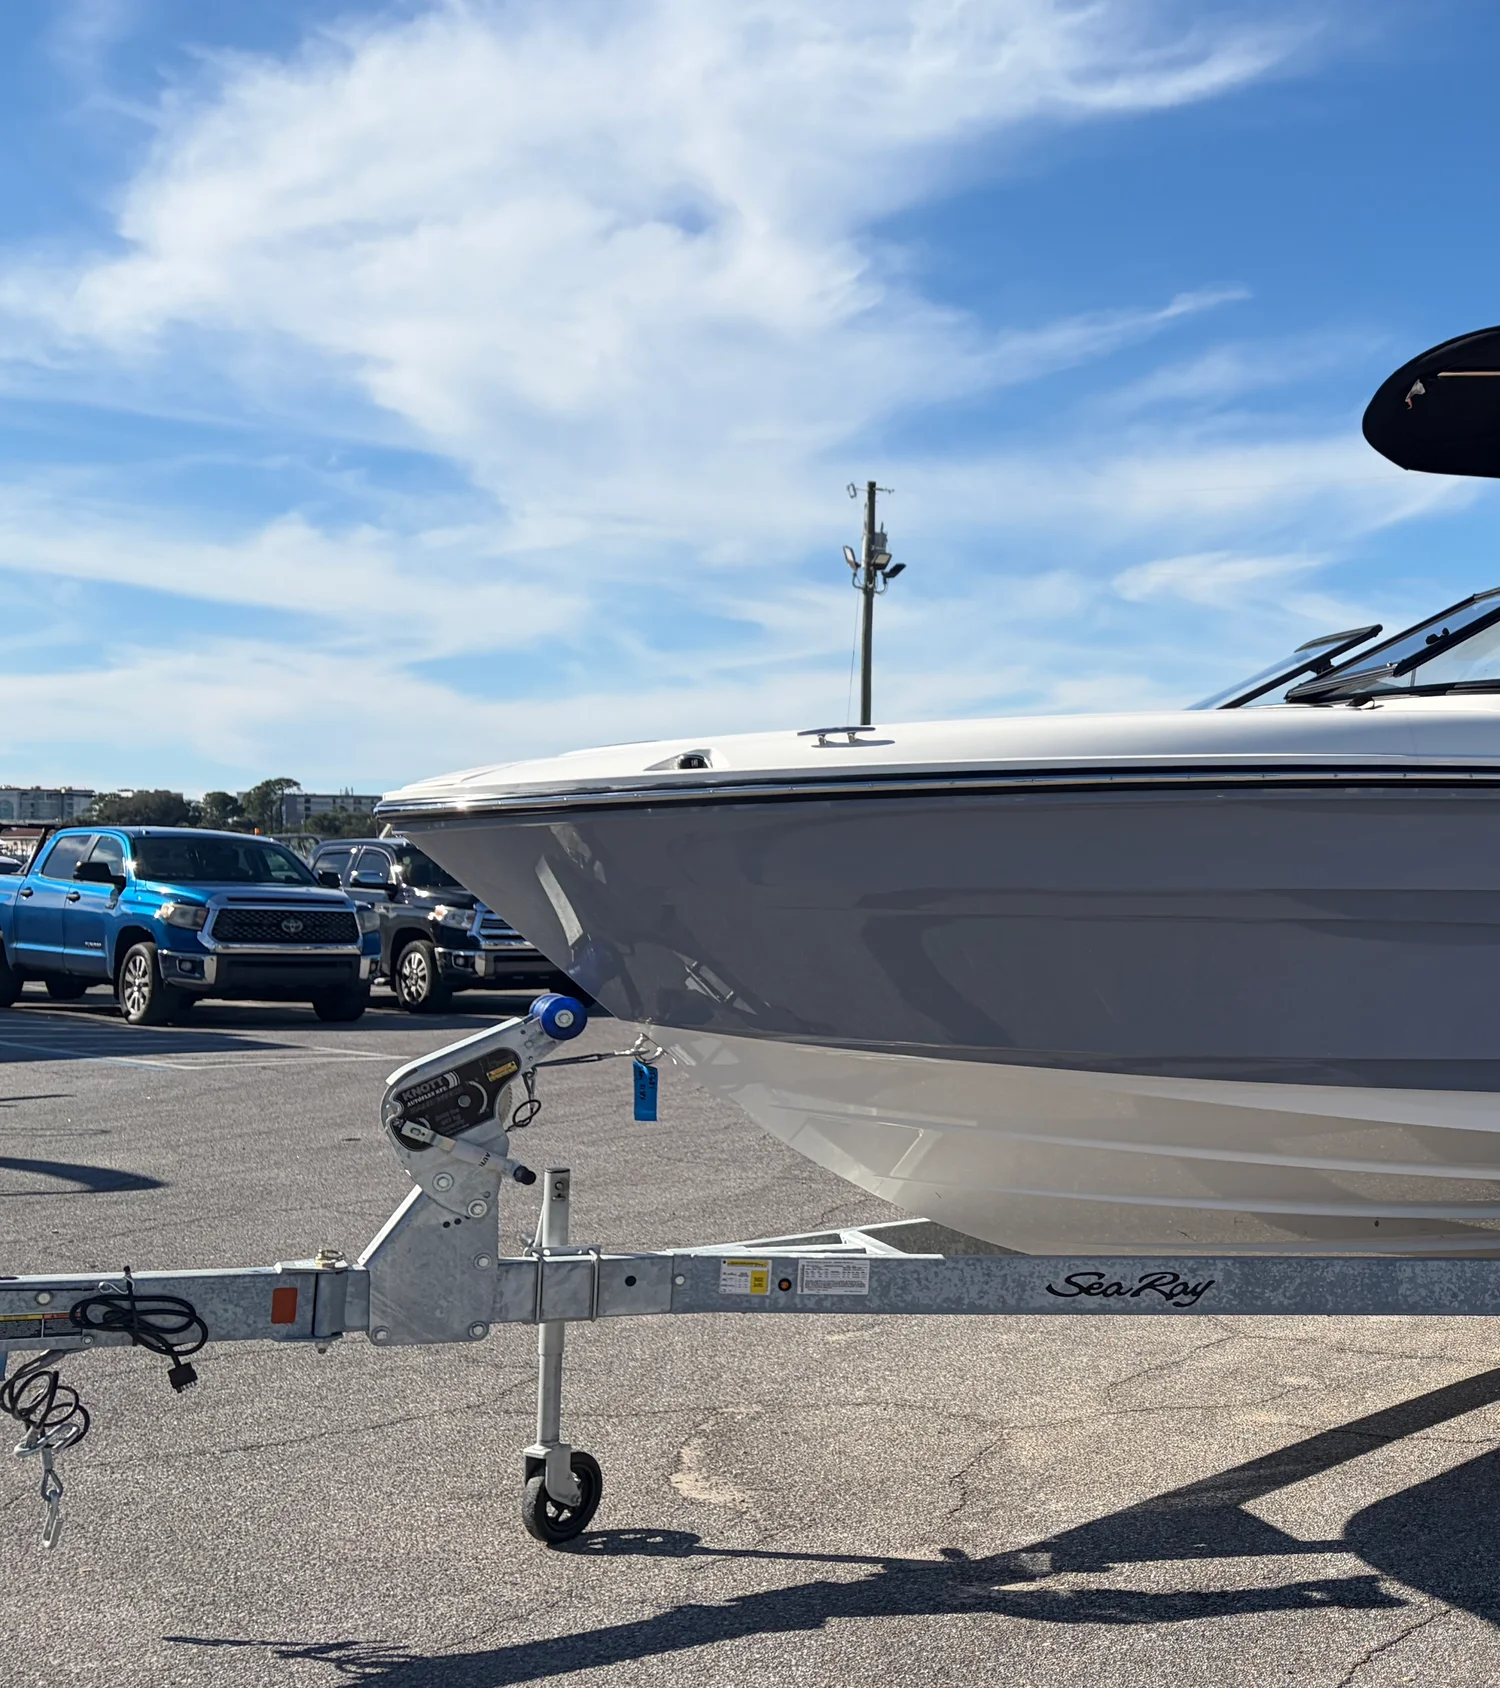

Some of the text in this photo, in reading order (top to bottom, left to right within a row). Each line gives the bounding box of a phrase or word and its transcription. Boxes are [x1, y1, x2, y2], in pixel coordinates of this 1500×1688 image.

[401, 1076, 444, 1102] KNOTT
[1045, 1271, 1216, 1308] Sea Ray
